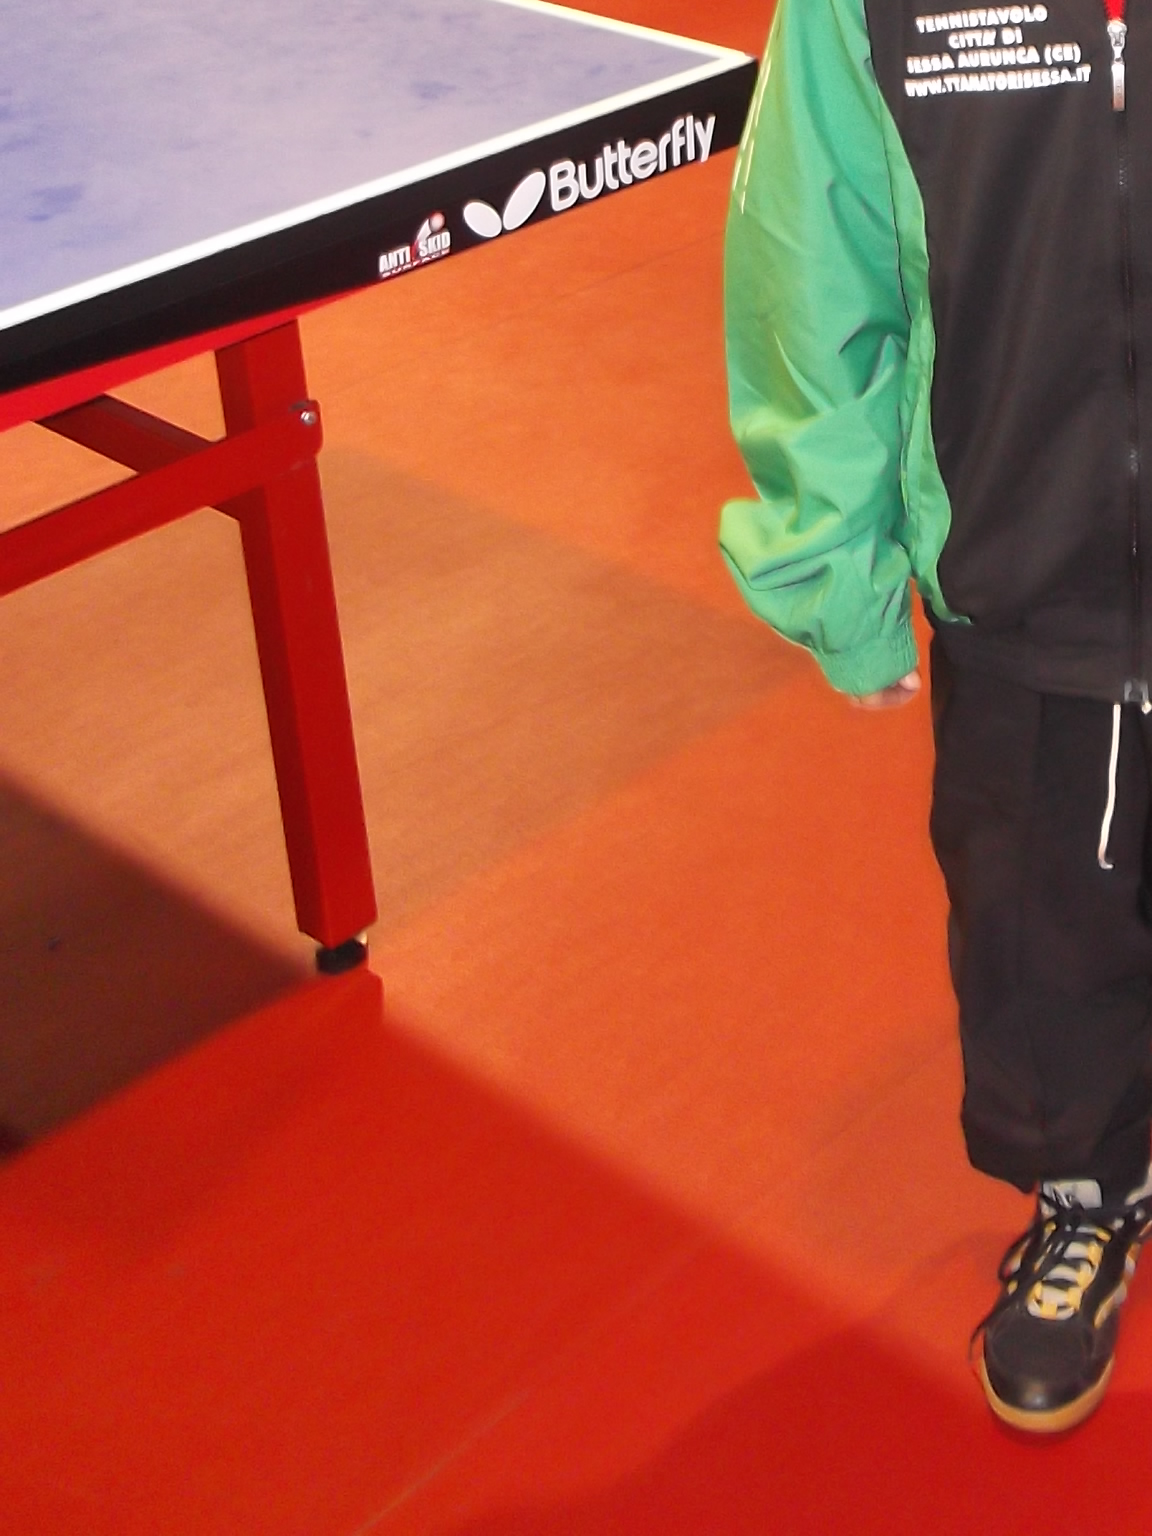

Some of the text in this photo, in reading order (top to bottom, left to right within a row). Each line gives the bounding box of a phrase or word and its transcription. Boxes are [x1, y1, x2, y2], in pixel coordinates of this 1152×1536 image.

[915, 4, 1048, 33] TENNISTAVOLO
[1002, 26, 1023, 45] DI
[550, 114, 716, 212] Butterfly
[379, 231, 451, 273] ANTI SKID
